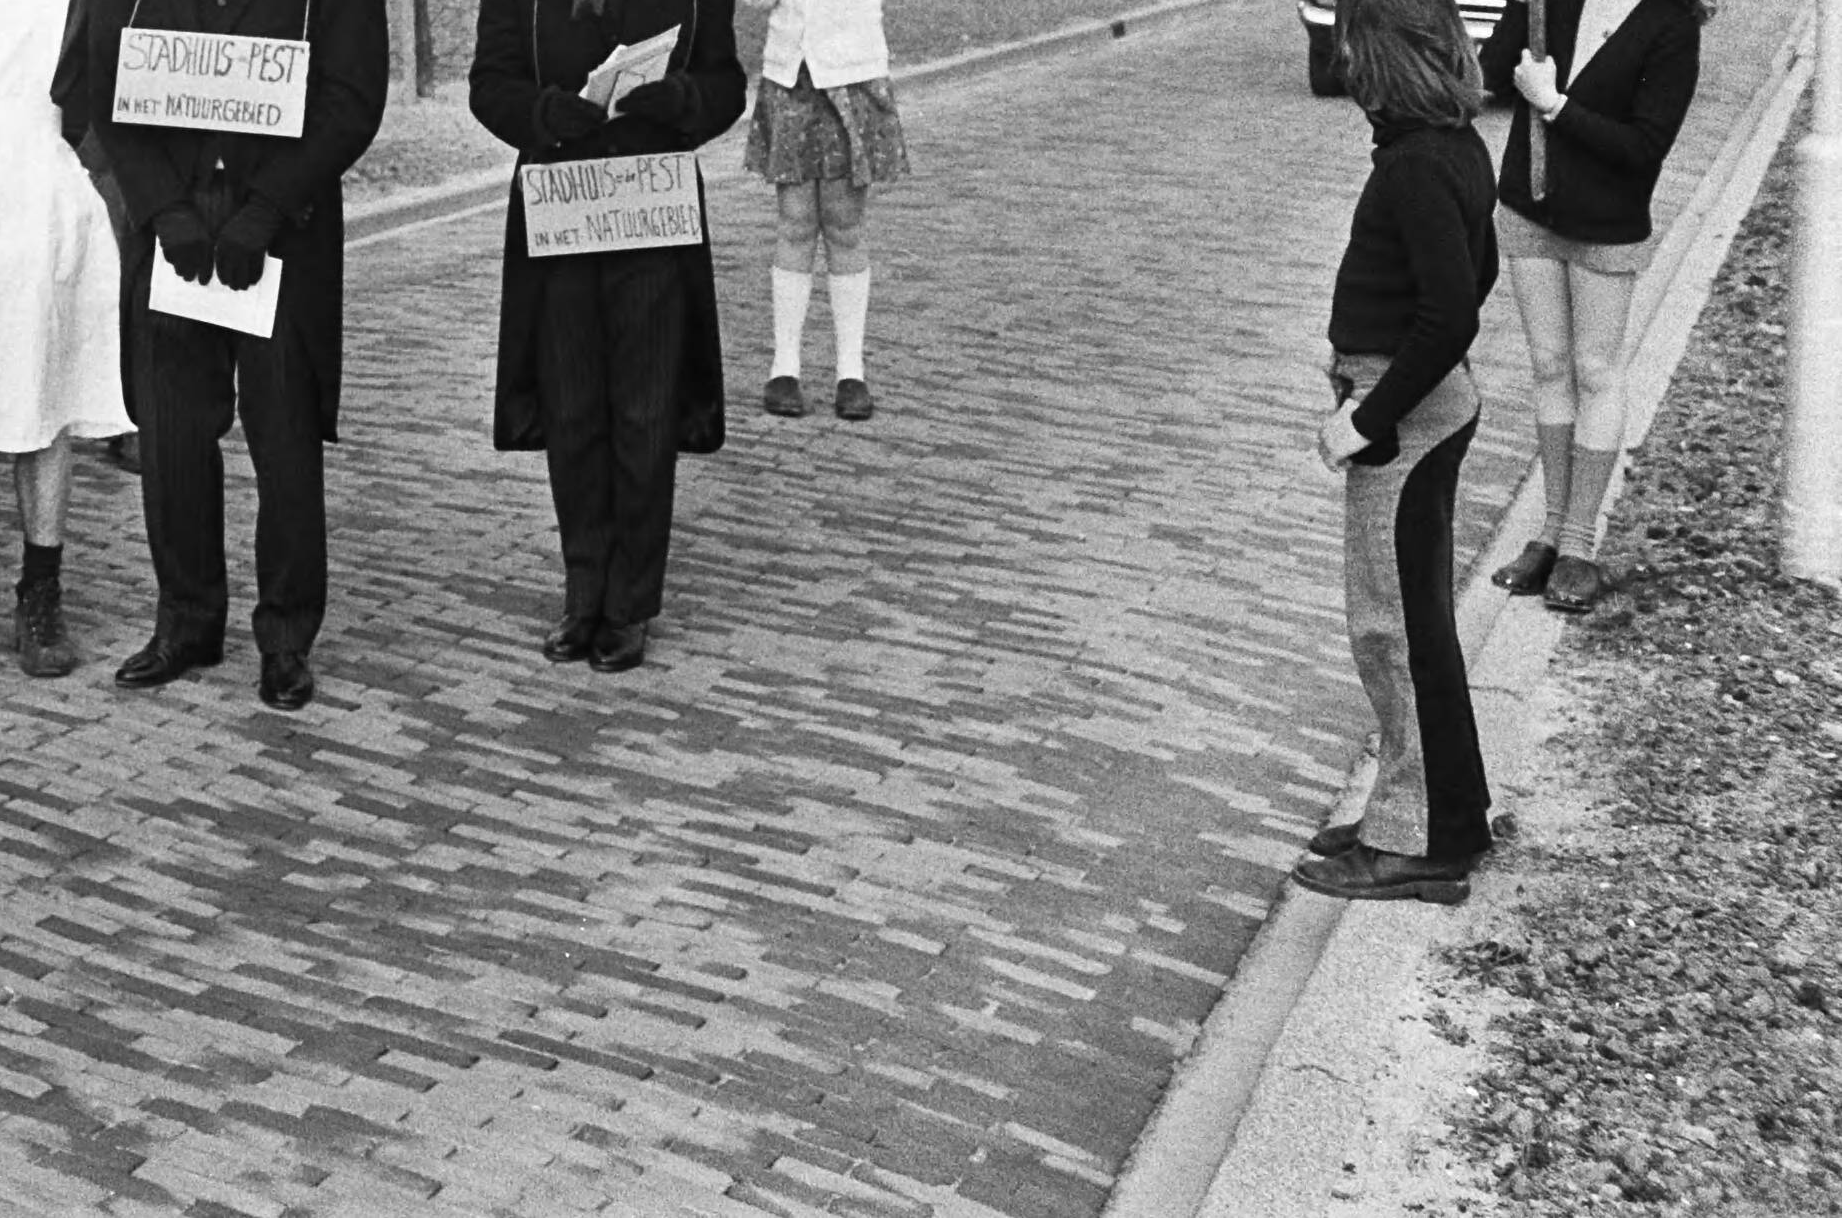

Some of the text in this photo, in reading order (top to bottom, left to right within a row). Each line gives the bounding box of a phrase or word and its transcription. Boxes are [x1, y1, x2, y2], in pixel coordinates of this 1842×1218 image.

[123, 32, 305, 84] STADHUIS PEST
[117, 92, 282, 127] IN HET NATUURGEBIED
[526, 160, 617, 205] STADHUIS
[637, 155, 686, 194] PEST
